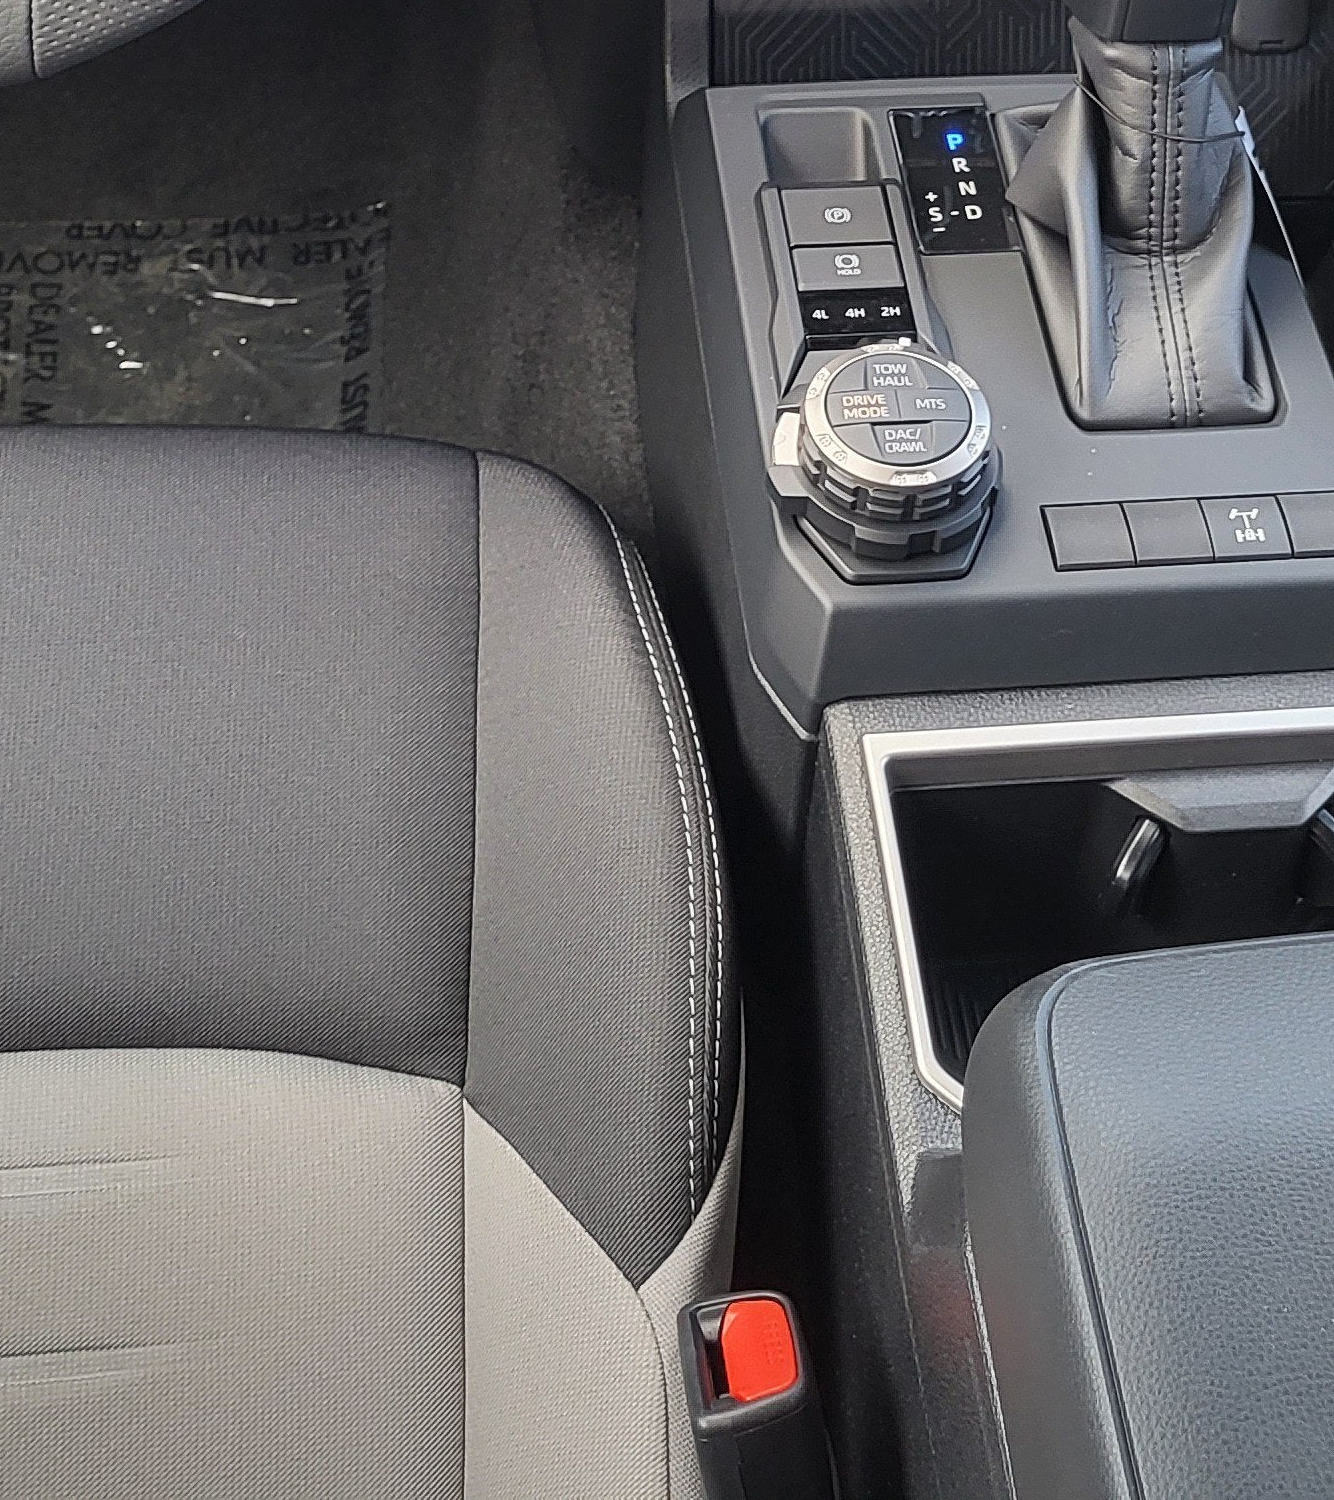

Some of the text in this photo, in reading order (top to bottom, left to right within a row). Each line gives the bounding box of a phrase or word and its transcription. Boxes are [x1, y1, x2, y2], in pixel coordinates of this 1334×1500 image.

[946, 133, 965, 151] P
[952, 157, 970, 174] R
[959, 181, 977, 196] N
[928, 205, 983, 222] S D
[836, 267, 862, 276] HOLD
[811, 306, 901, 320] 4L 4H 2H
[23, 281, 64, 384] DEALER
[873, 363, 908, 375] TOW
[873, 375, 913, 387] HAUL
[842, 394, 887, 407] DRIVE
[915, 398, 947, 410] MTS
[843, 406, 890, 419] MODE
[884, 428, 922, 441] DAC/
[884, 441, 928, 454] CRAWL
